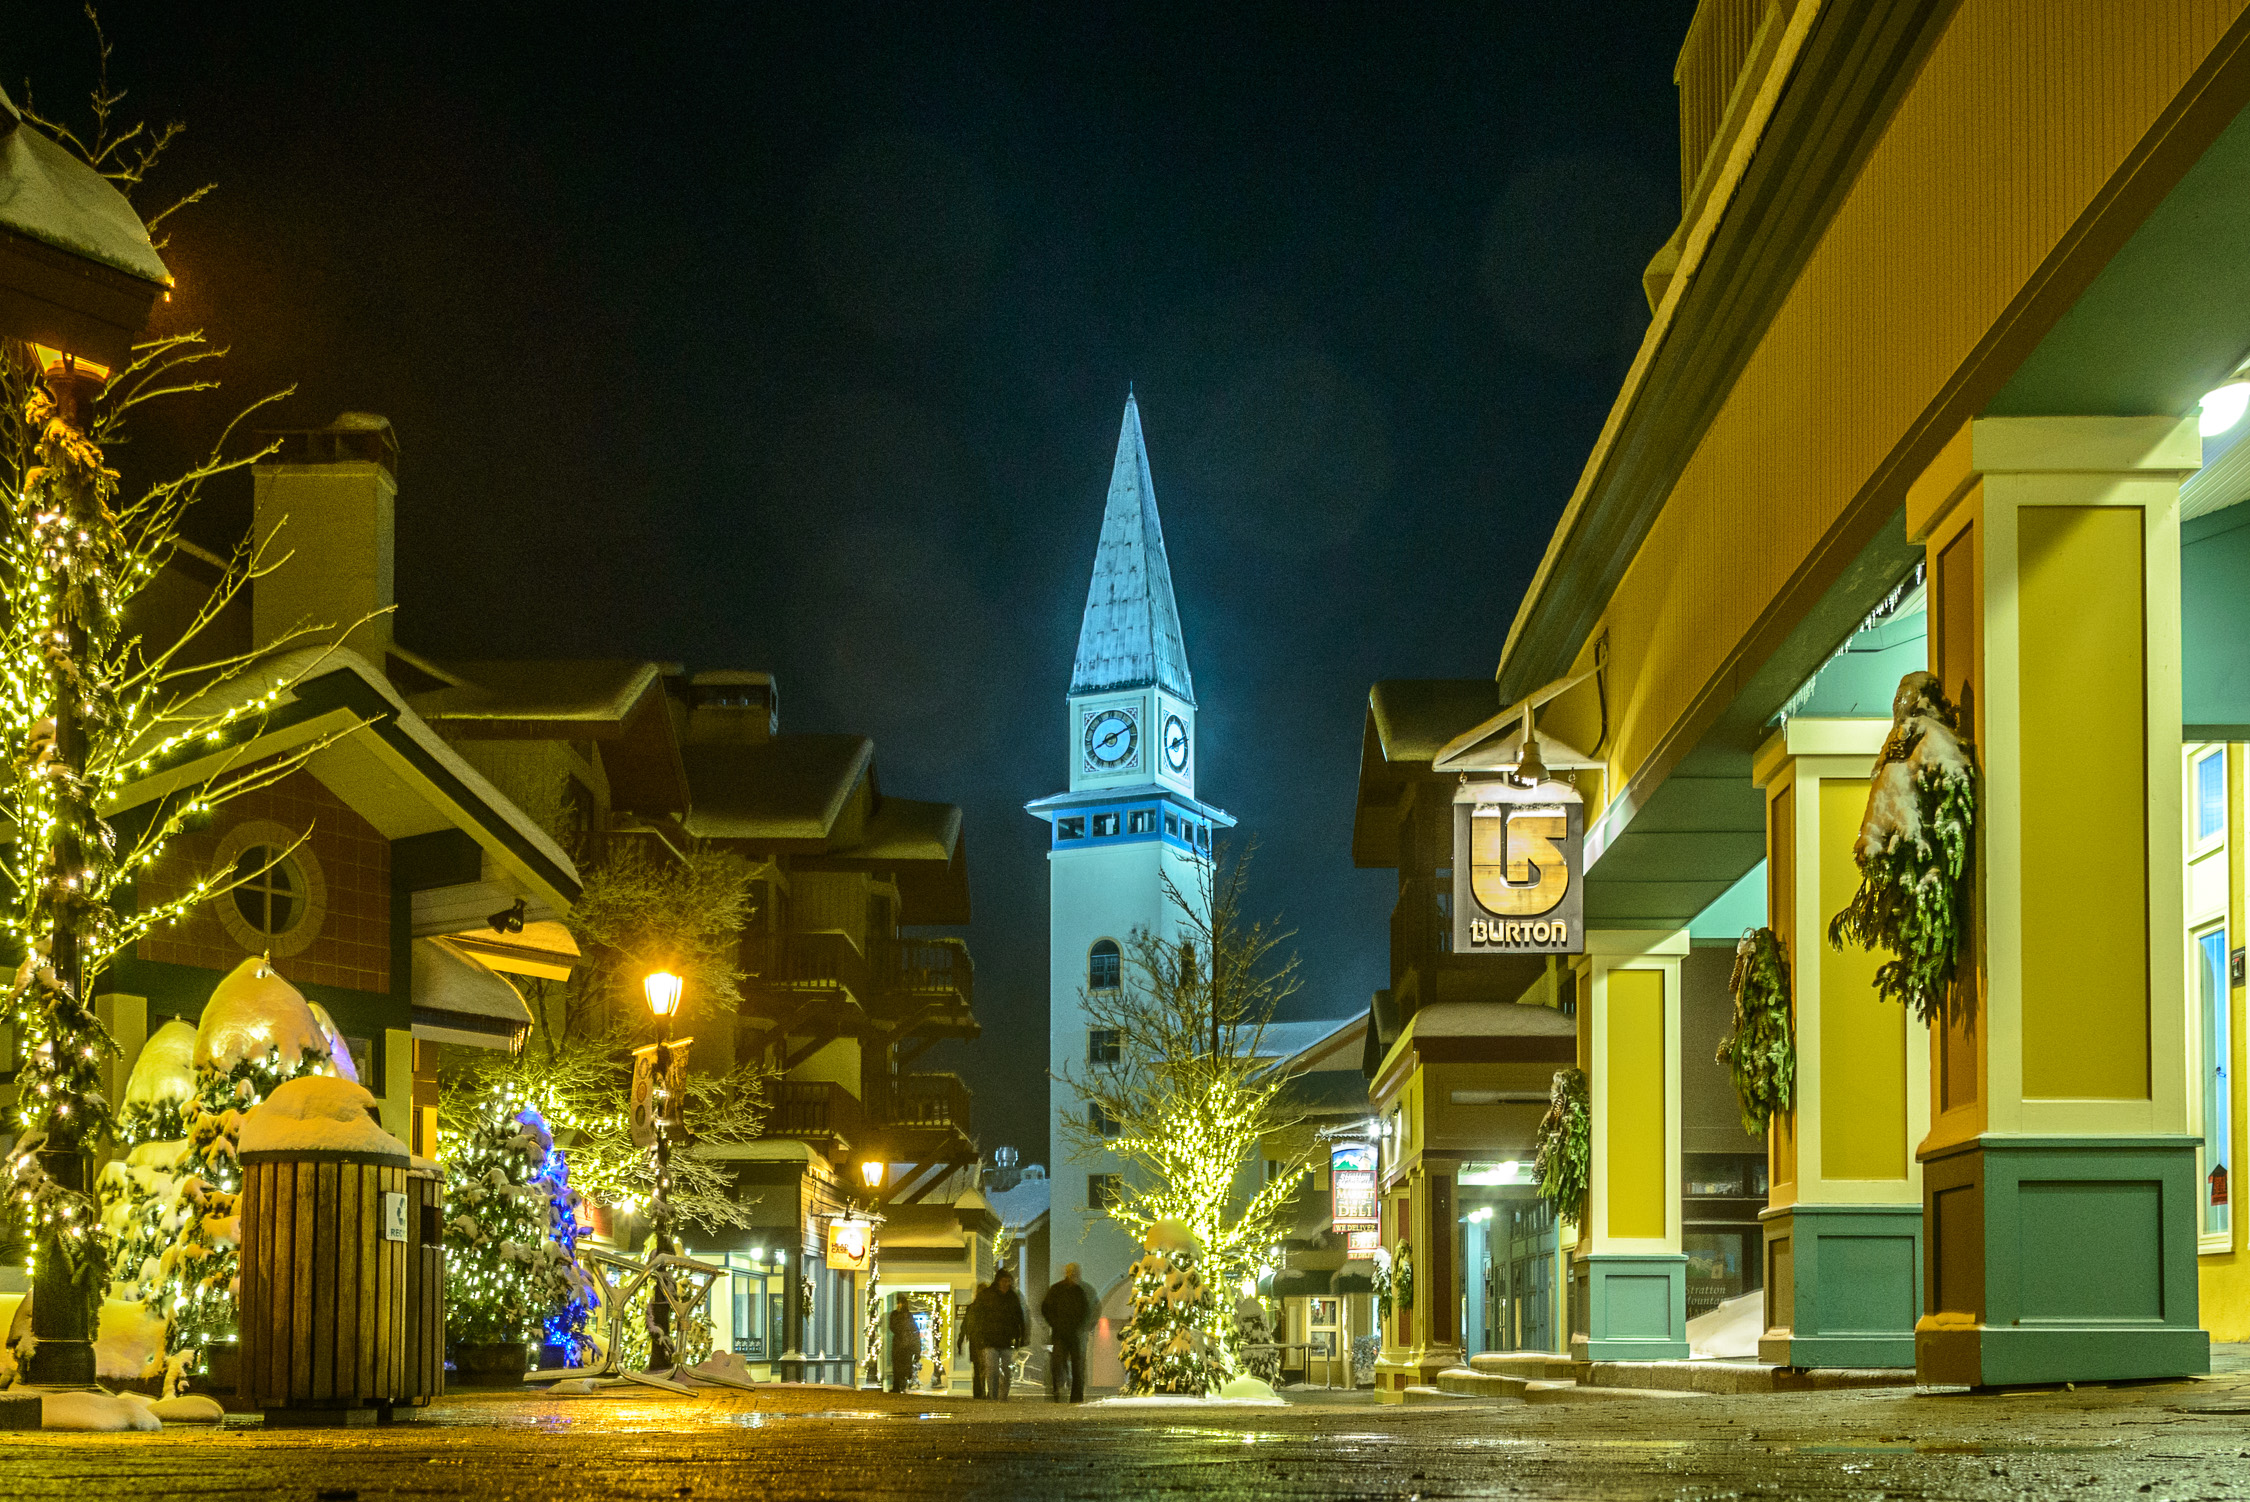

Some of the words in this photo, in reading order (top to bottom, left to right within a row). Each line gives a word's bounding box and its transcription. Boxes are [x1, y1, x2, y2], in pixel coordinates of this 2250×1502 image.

[1470, 918, 1567, 942] BURTON
[1338, 1206, 1372, 1217] DELI
[1686, 1285, 1726, 1295] Stratton
